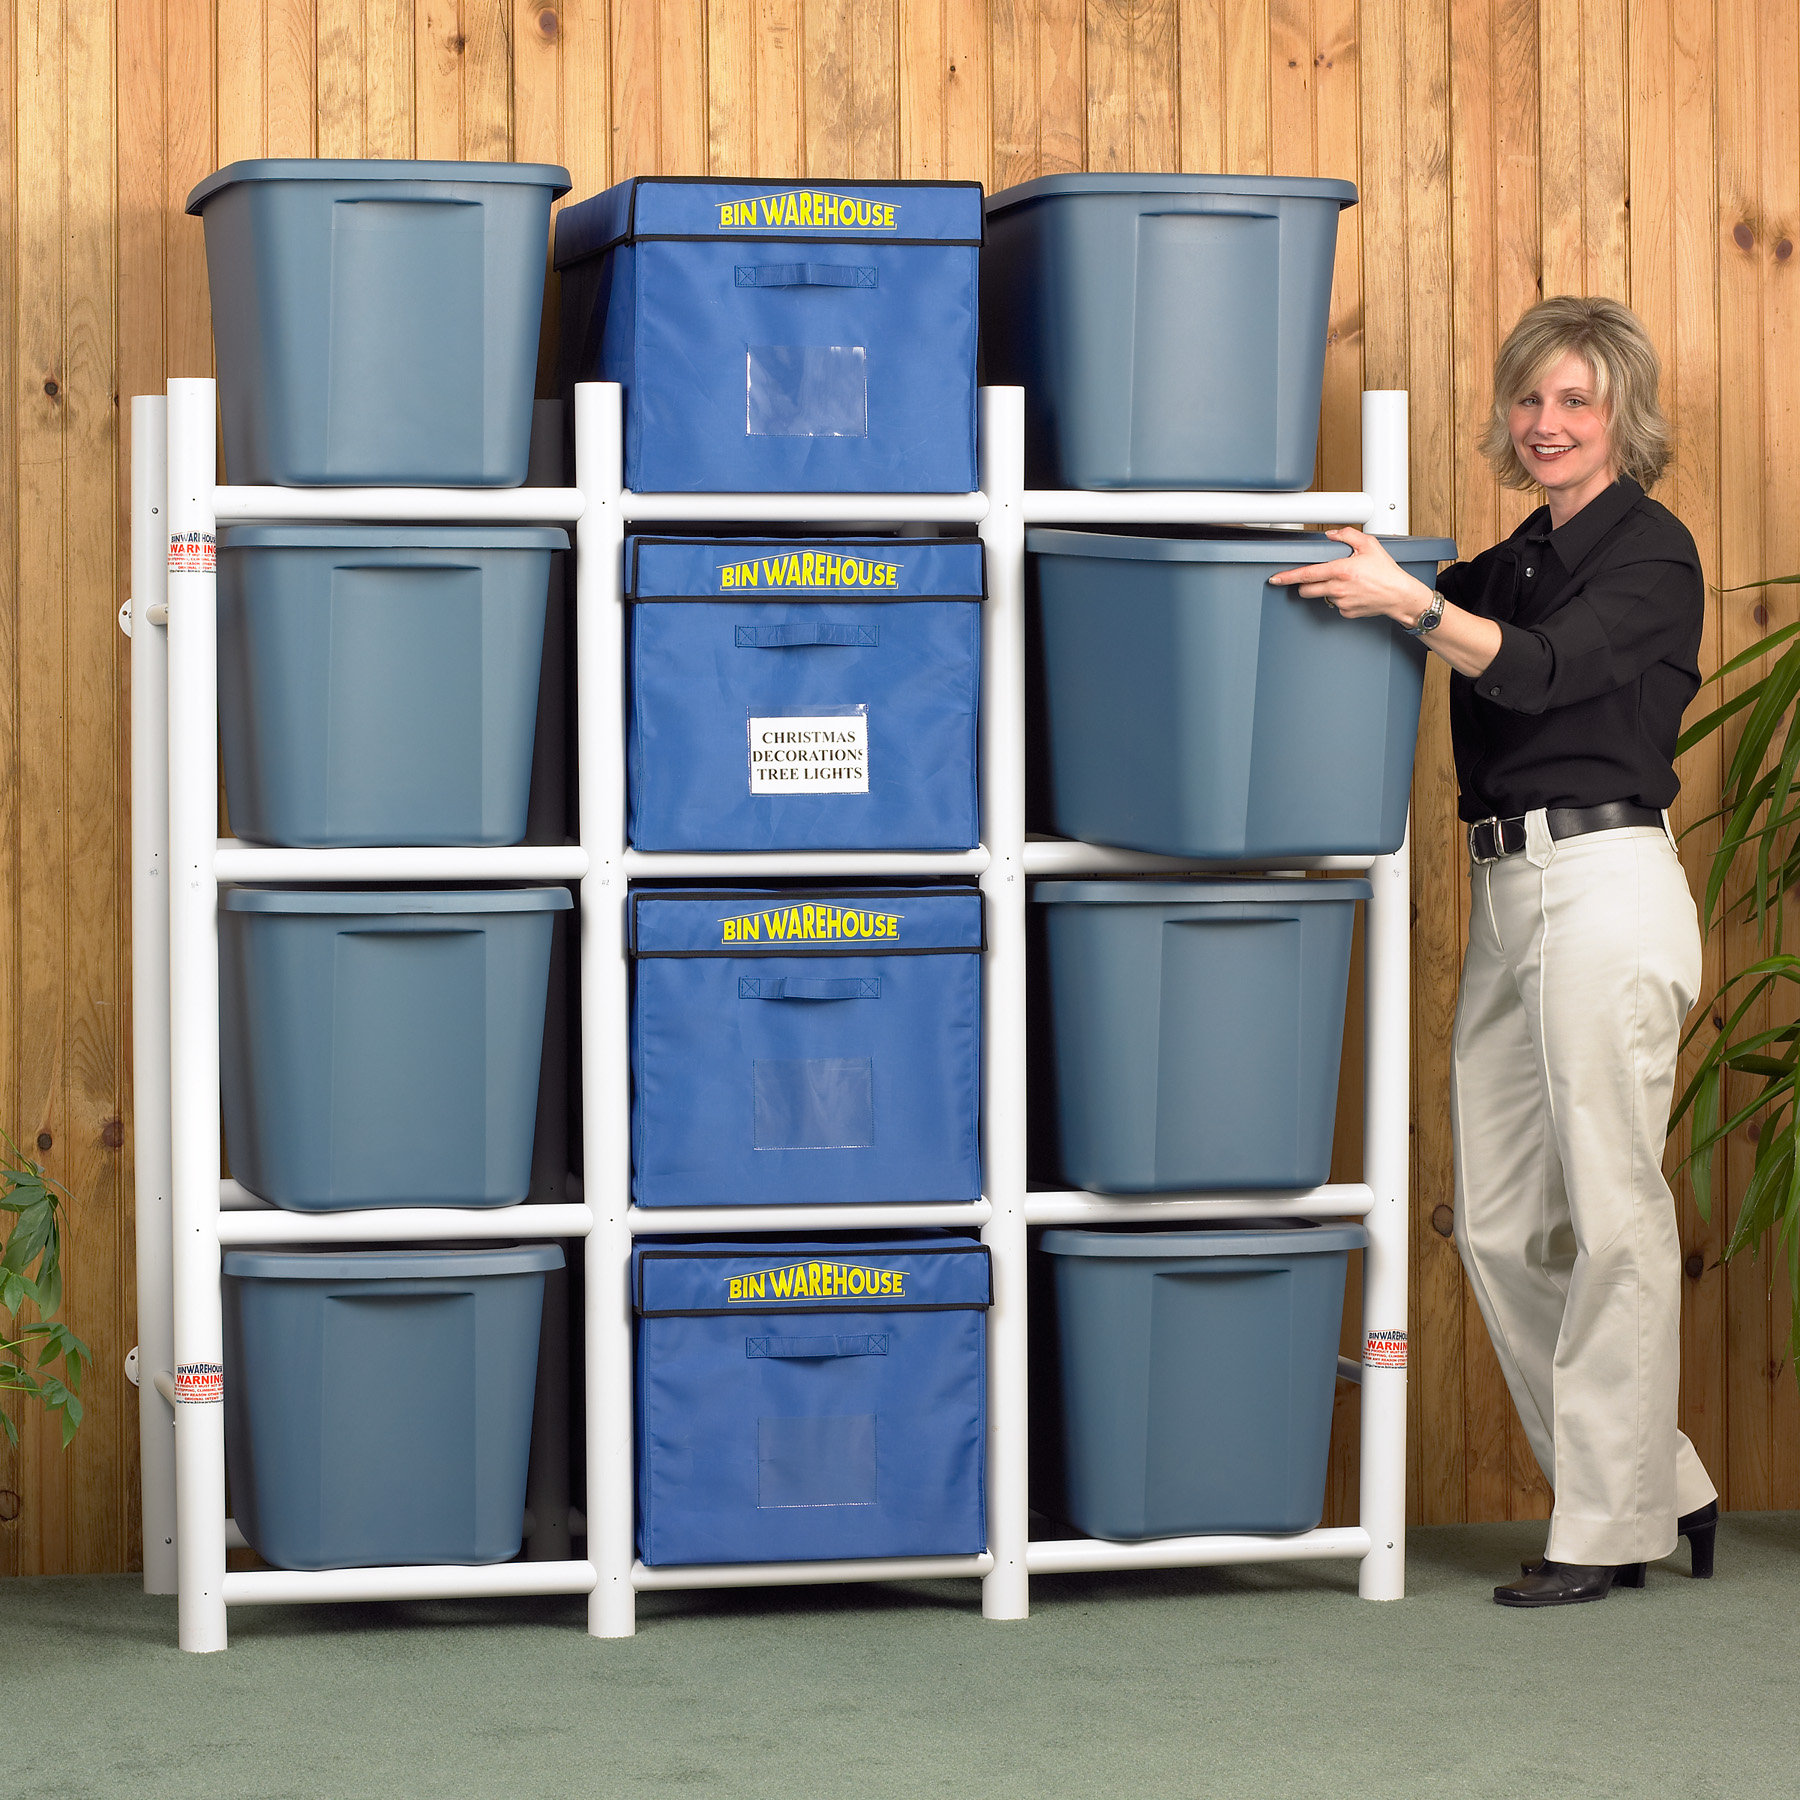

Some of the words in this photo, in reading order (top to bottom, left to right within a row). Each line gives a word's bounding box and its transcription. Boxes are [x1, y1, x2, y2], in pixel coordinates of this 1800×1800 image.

[721, 200, 757, 226] BIN
[760, 192, 895, 227] WAREHOUSE
[722, 561, 759, 587] BIN
[762, 552, 897, 587] WAREHOUSE
[762, 731, 856, 744] CHRISTMAS
[757, 768, 799, 780] TREE
[804, 767, 862, 780] LIGHTS
[723, 915, 760, 941] BIN
[763, 905, 898, 940] WAREHOUSE
[730, 1273, 766, 1299] BIN
[769, 1263, 903, 1298] WAREHOUSE
[1367, 1340, 1407, 1350] WARNIN
